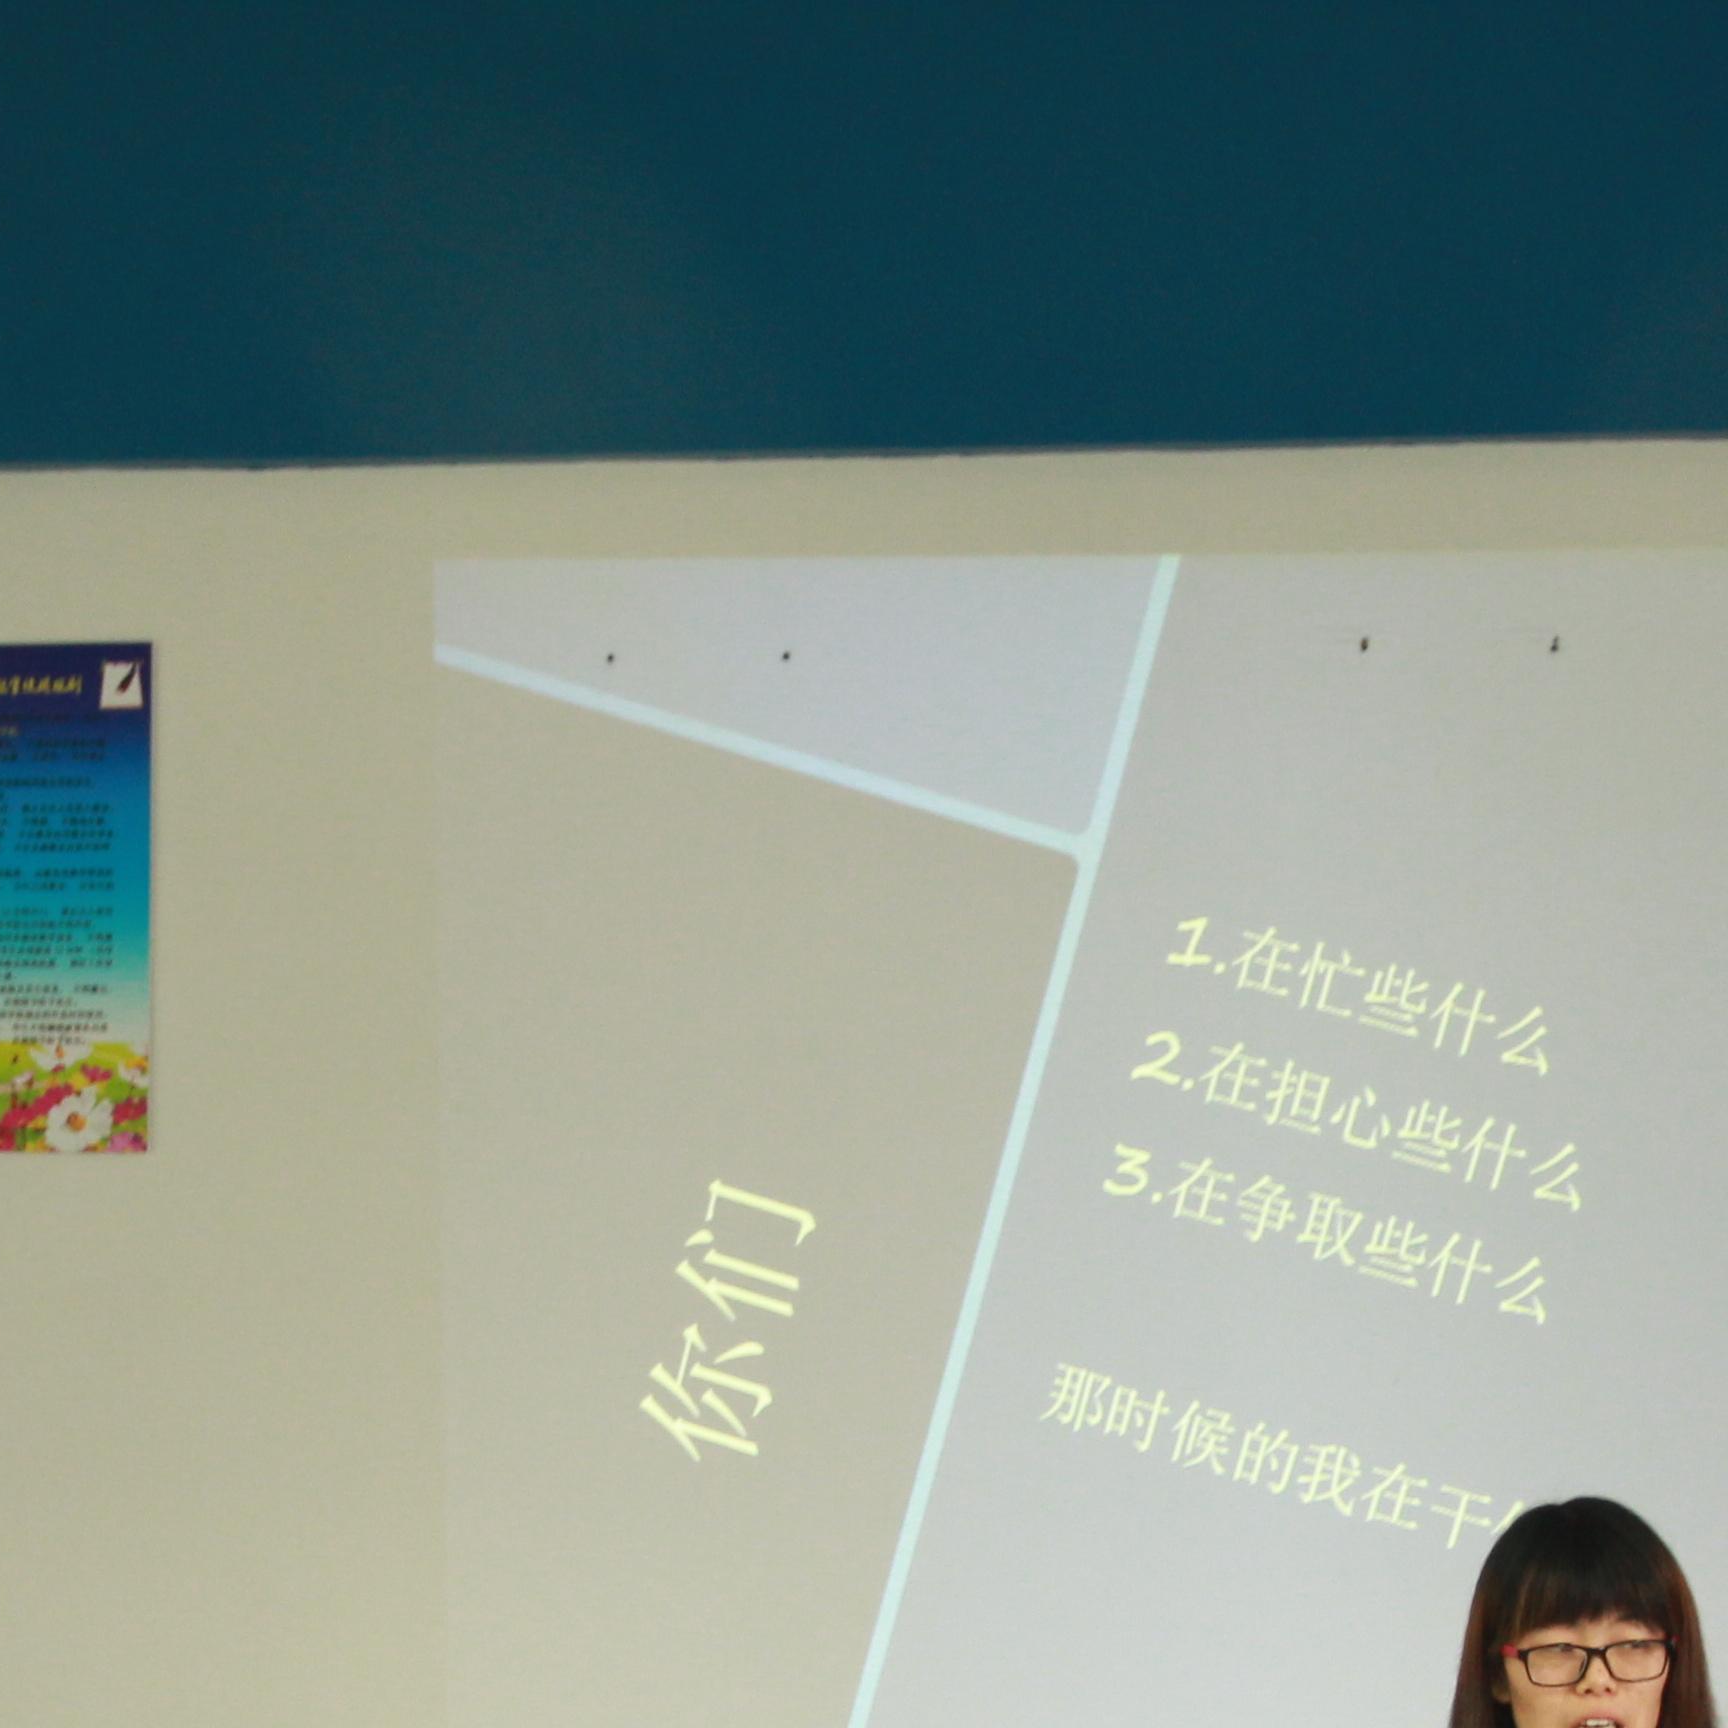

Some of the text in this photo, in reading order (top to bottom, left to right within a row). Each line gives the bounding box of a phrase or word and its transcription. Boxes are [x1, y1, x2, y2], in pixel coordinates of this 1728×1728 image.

[1166, 917, 1550, 1076] 1.在忙些什么
[1130, 1030, 1583, 1211] 2.在担心些什么
[639, 1178, 817, 1463] 你们
[1101, 1142, 1548, 1325] 3.在争取些什么
[1039, 1362, 1526, 1550] 那时候的我在干
